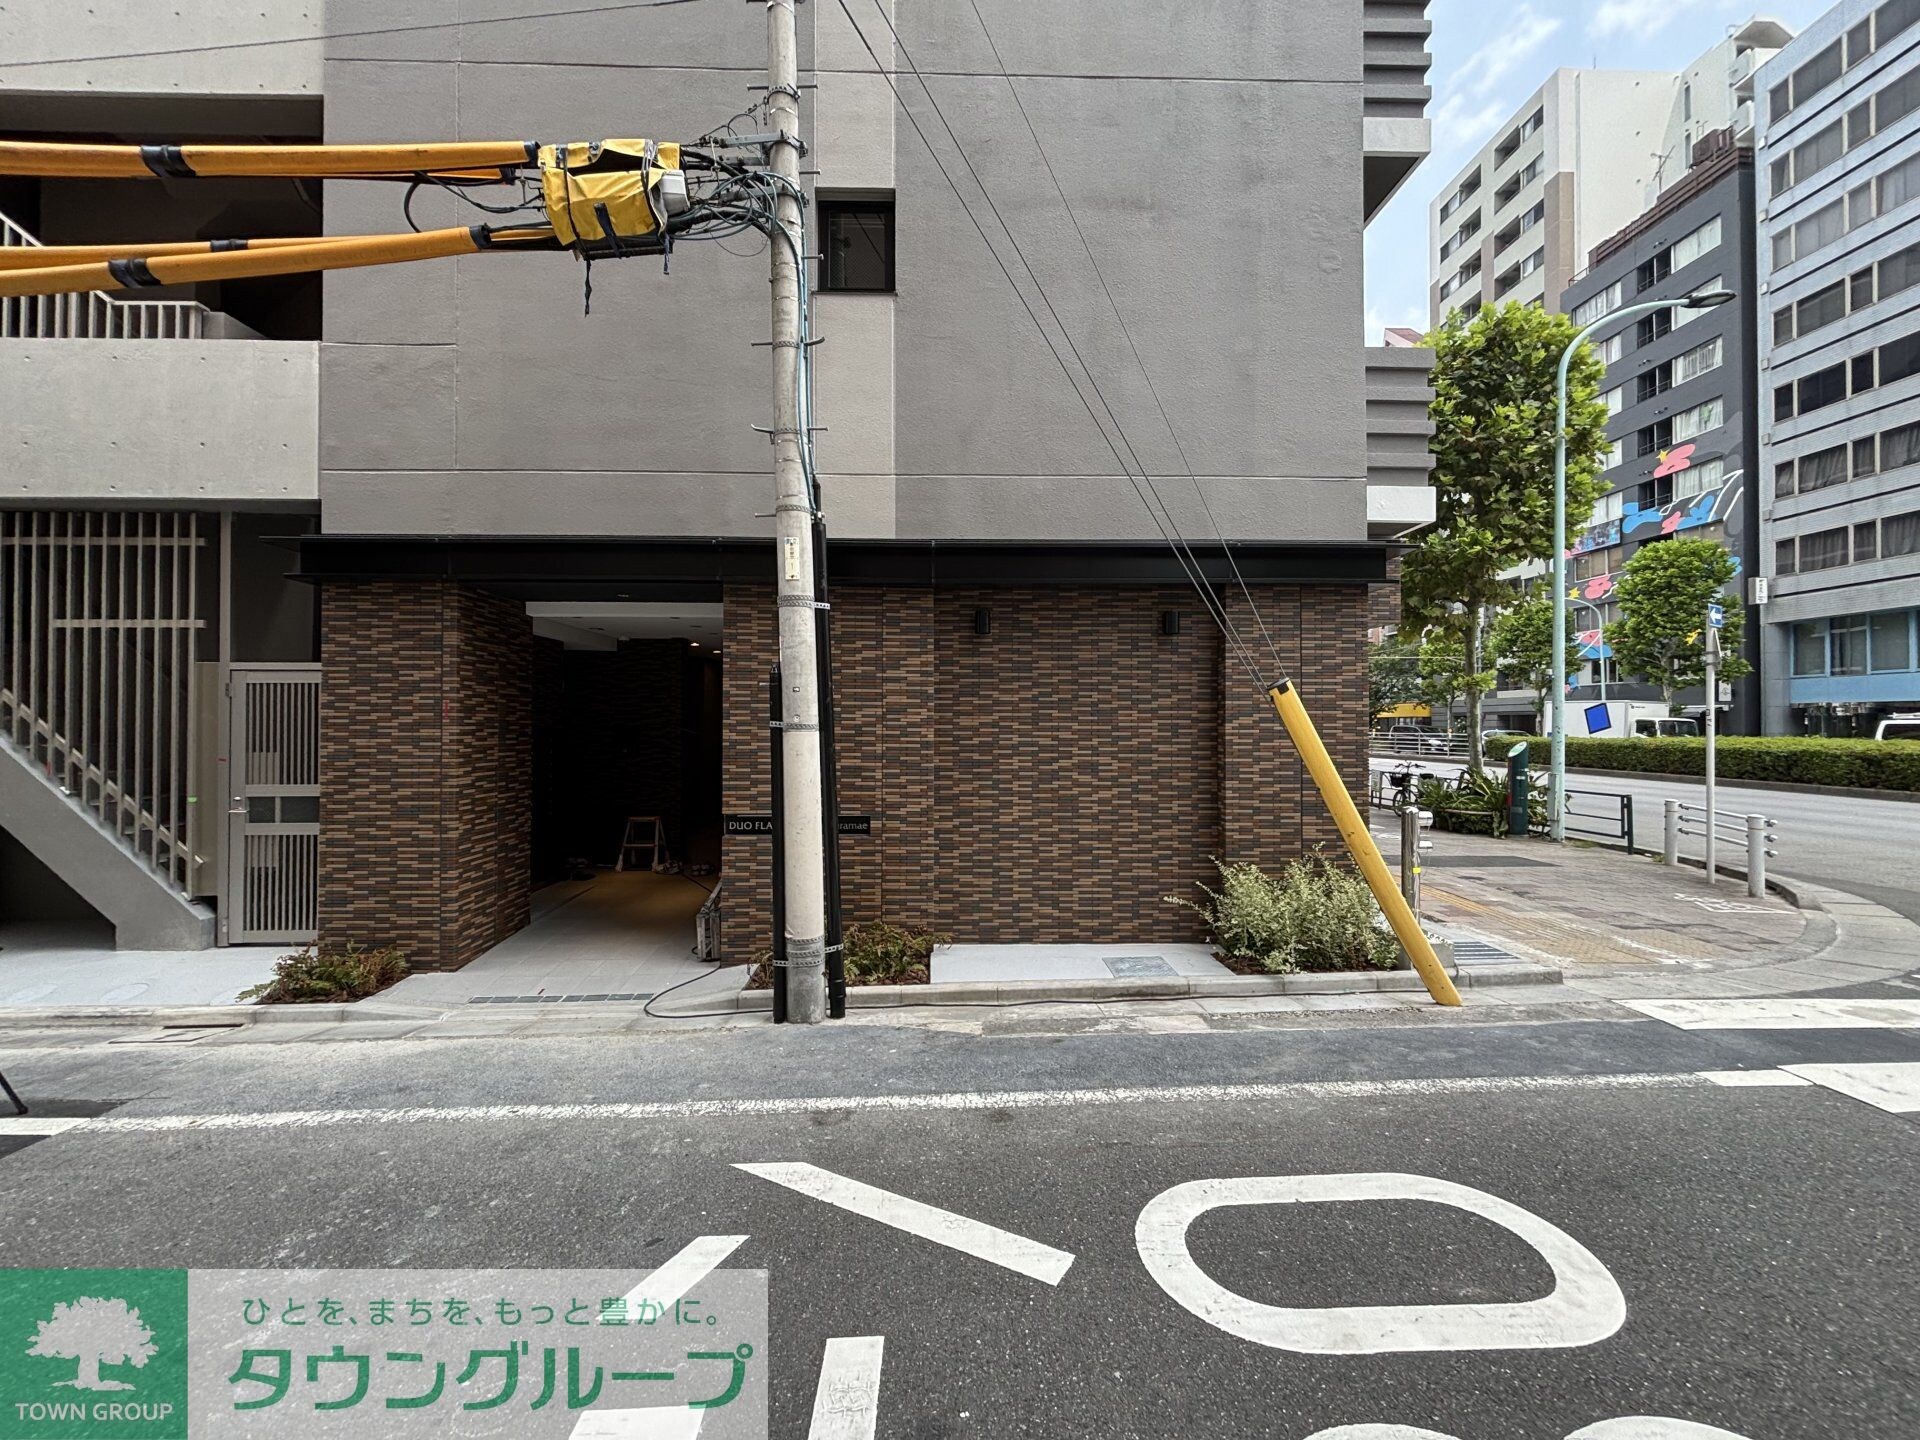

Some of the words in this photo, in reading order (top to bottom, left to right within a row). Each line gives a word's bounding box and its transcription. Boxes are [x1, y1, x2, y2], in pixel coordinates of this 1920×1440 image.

[729, 821, 753, 830] DUO
[755, 821, 773, 830] FLA
[837, 822, 868, 830] ramae
